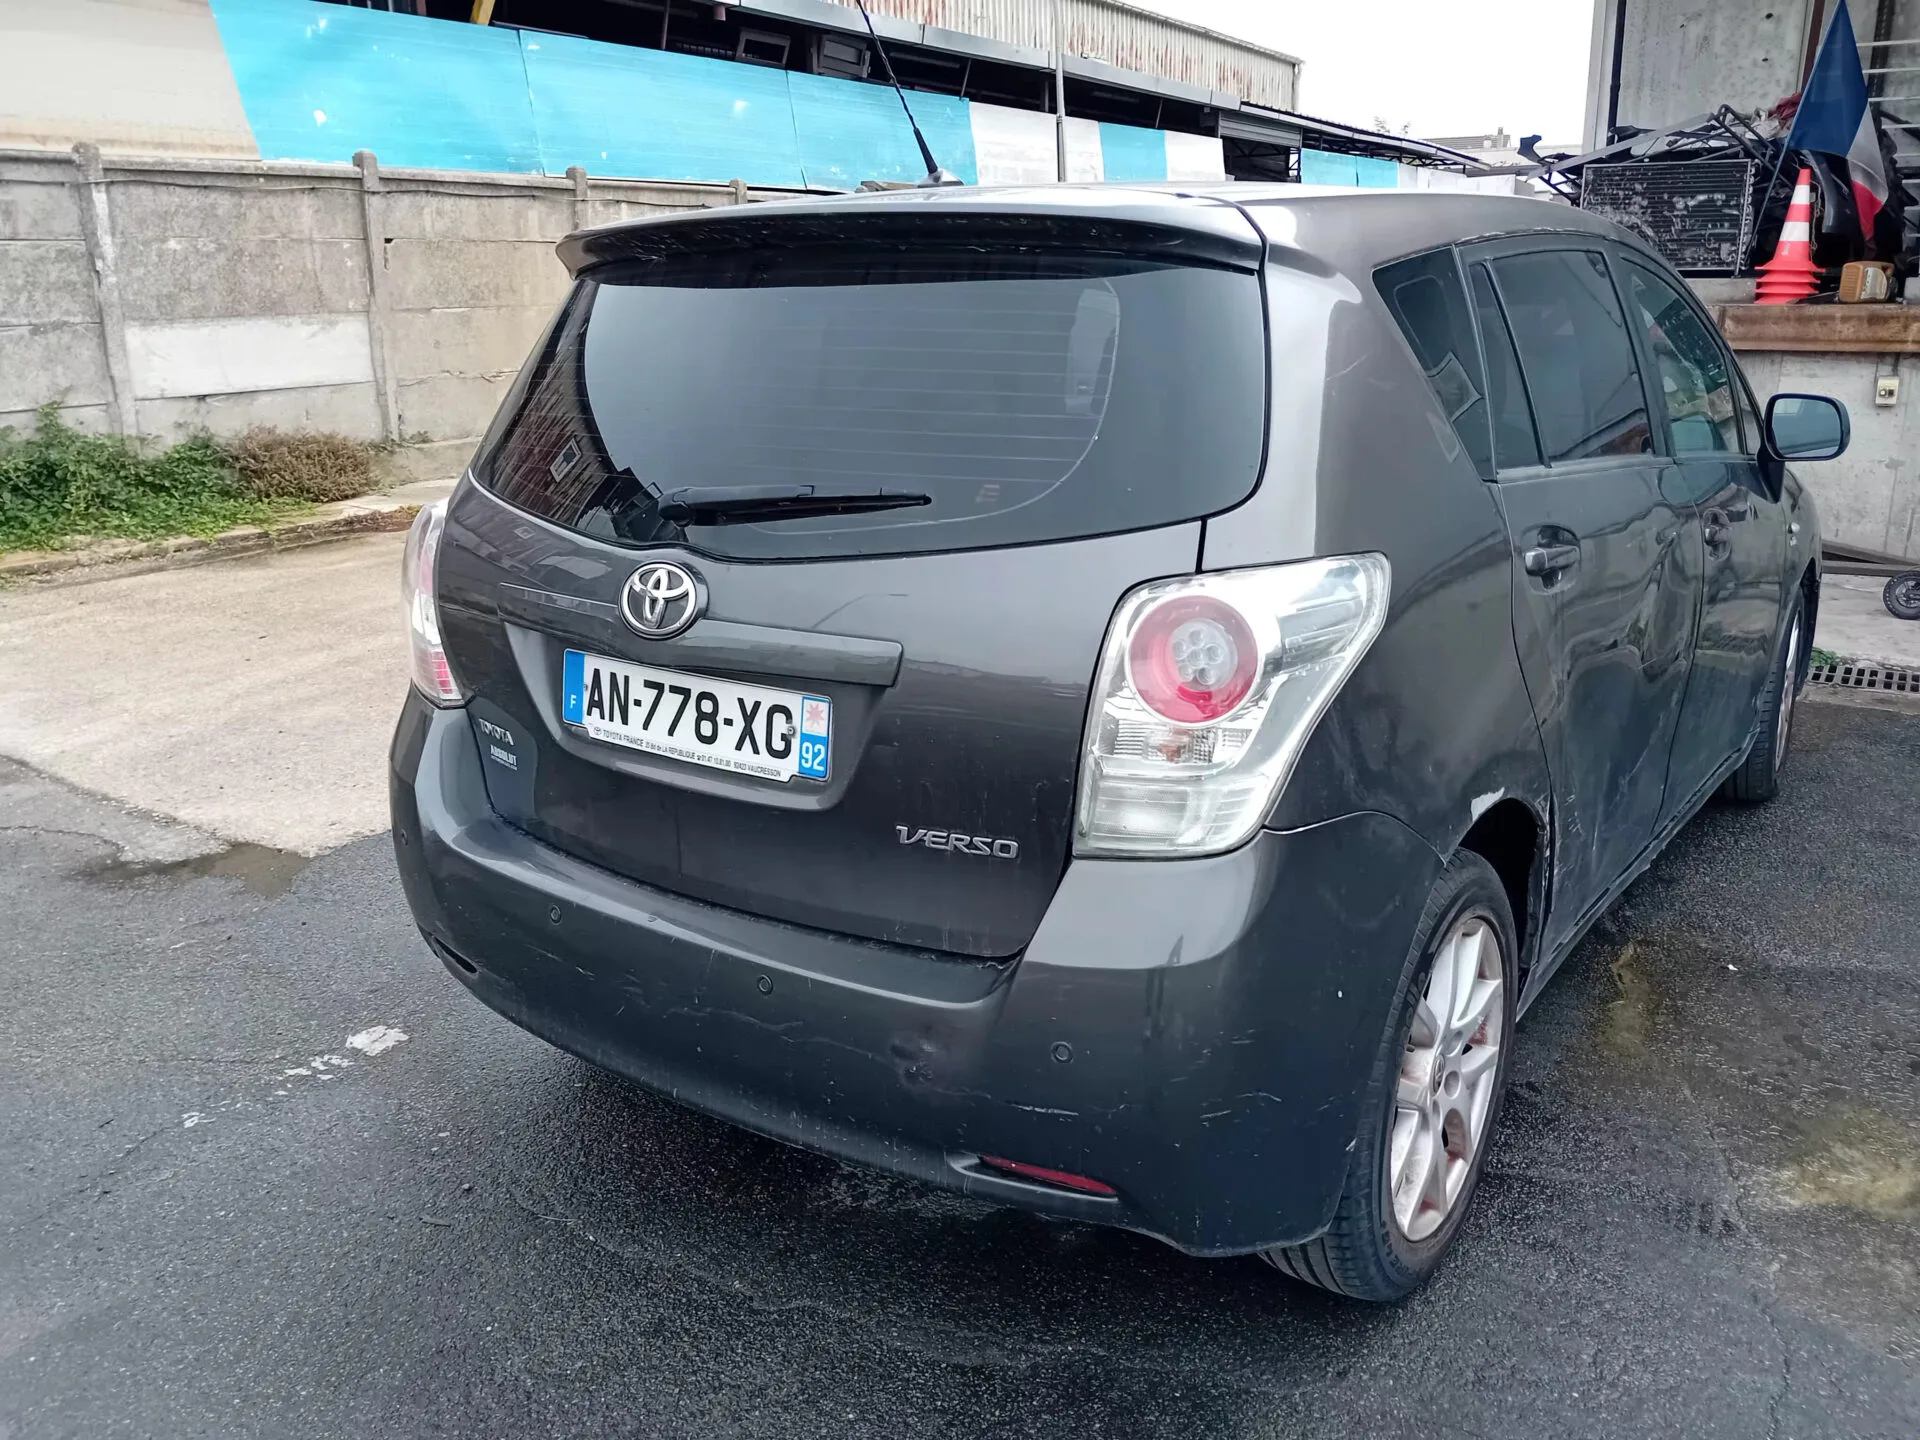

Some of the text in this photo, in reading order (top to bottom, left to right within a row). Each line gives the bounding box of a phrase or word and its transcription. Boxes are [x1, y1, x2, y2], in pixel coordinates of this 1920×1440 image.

[569, 694, 577, 709] F
[586, 667, 794, 760] AN-778-XG
[478, 718, 515, 746] TOYOTA
[603, 729, 622, 741] TOYOTA
[623, 734, 644, 747] FRANCE
[747, 765, 782, 777] VAUCRESSON
[800, 741, 826, 771] 92
[895, 825, 1019, 859] VERSO
